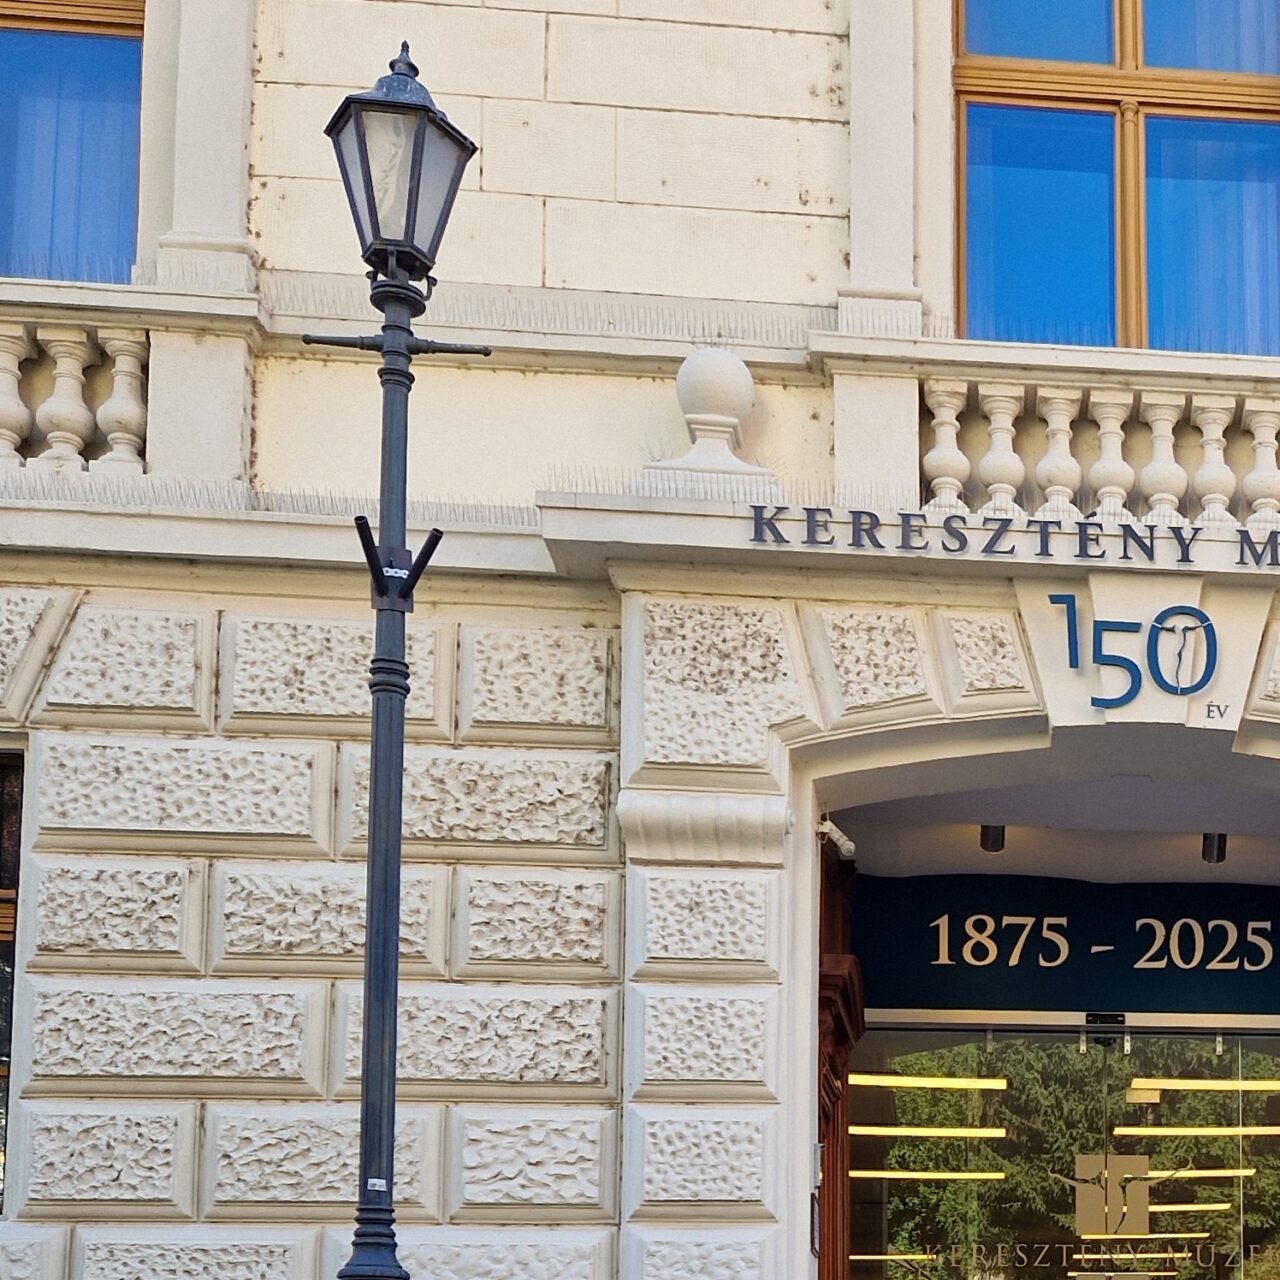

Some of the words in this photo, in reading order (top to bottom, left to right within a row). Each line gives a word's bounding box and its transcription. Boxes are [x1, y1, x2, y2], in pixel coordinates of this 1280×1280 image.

[749, 504, 1203, 563] KERESZTÉNY
[1048, 594, 1218, 709] 150
[1206, 701, 1229, 719] ÉV
[928, 914, 1070, 967] 1875
[1133, 918, 1273, 971] 2025
